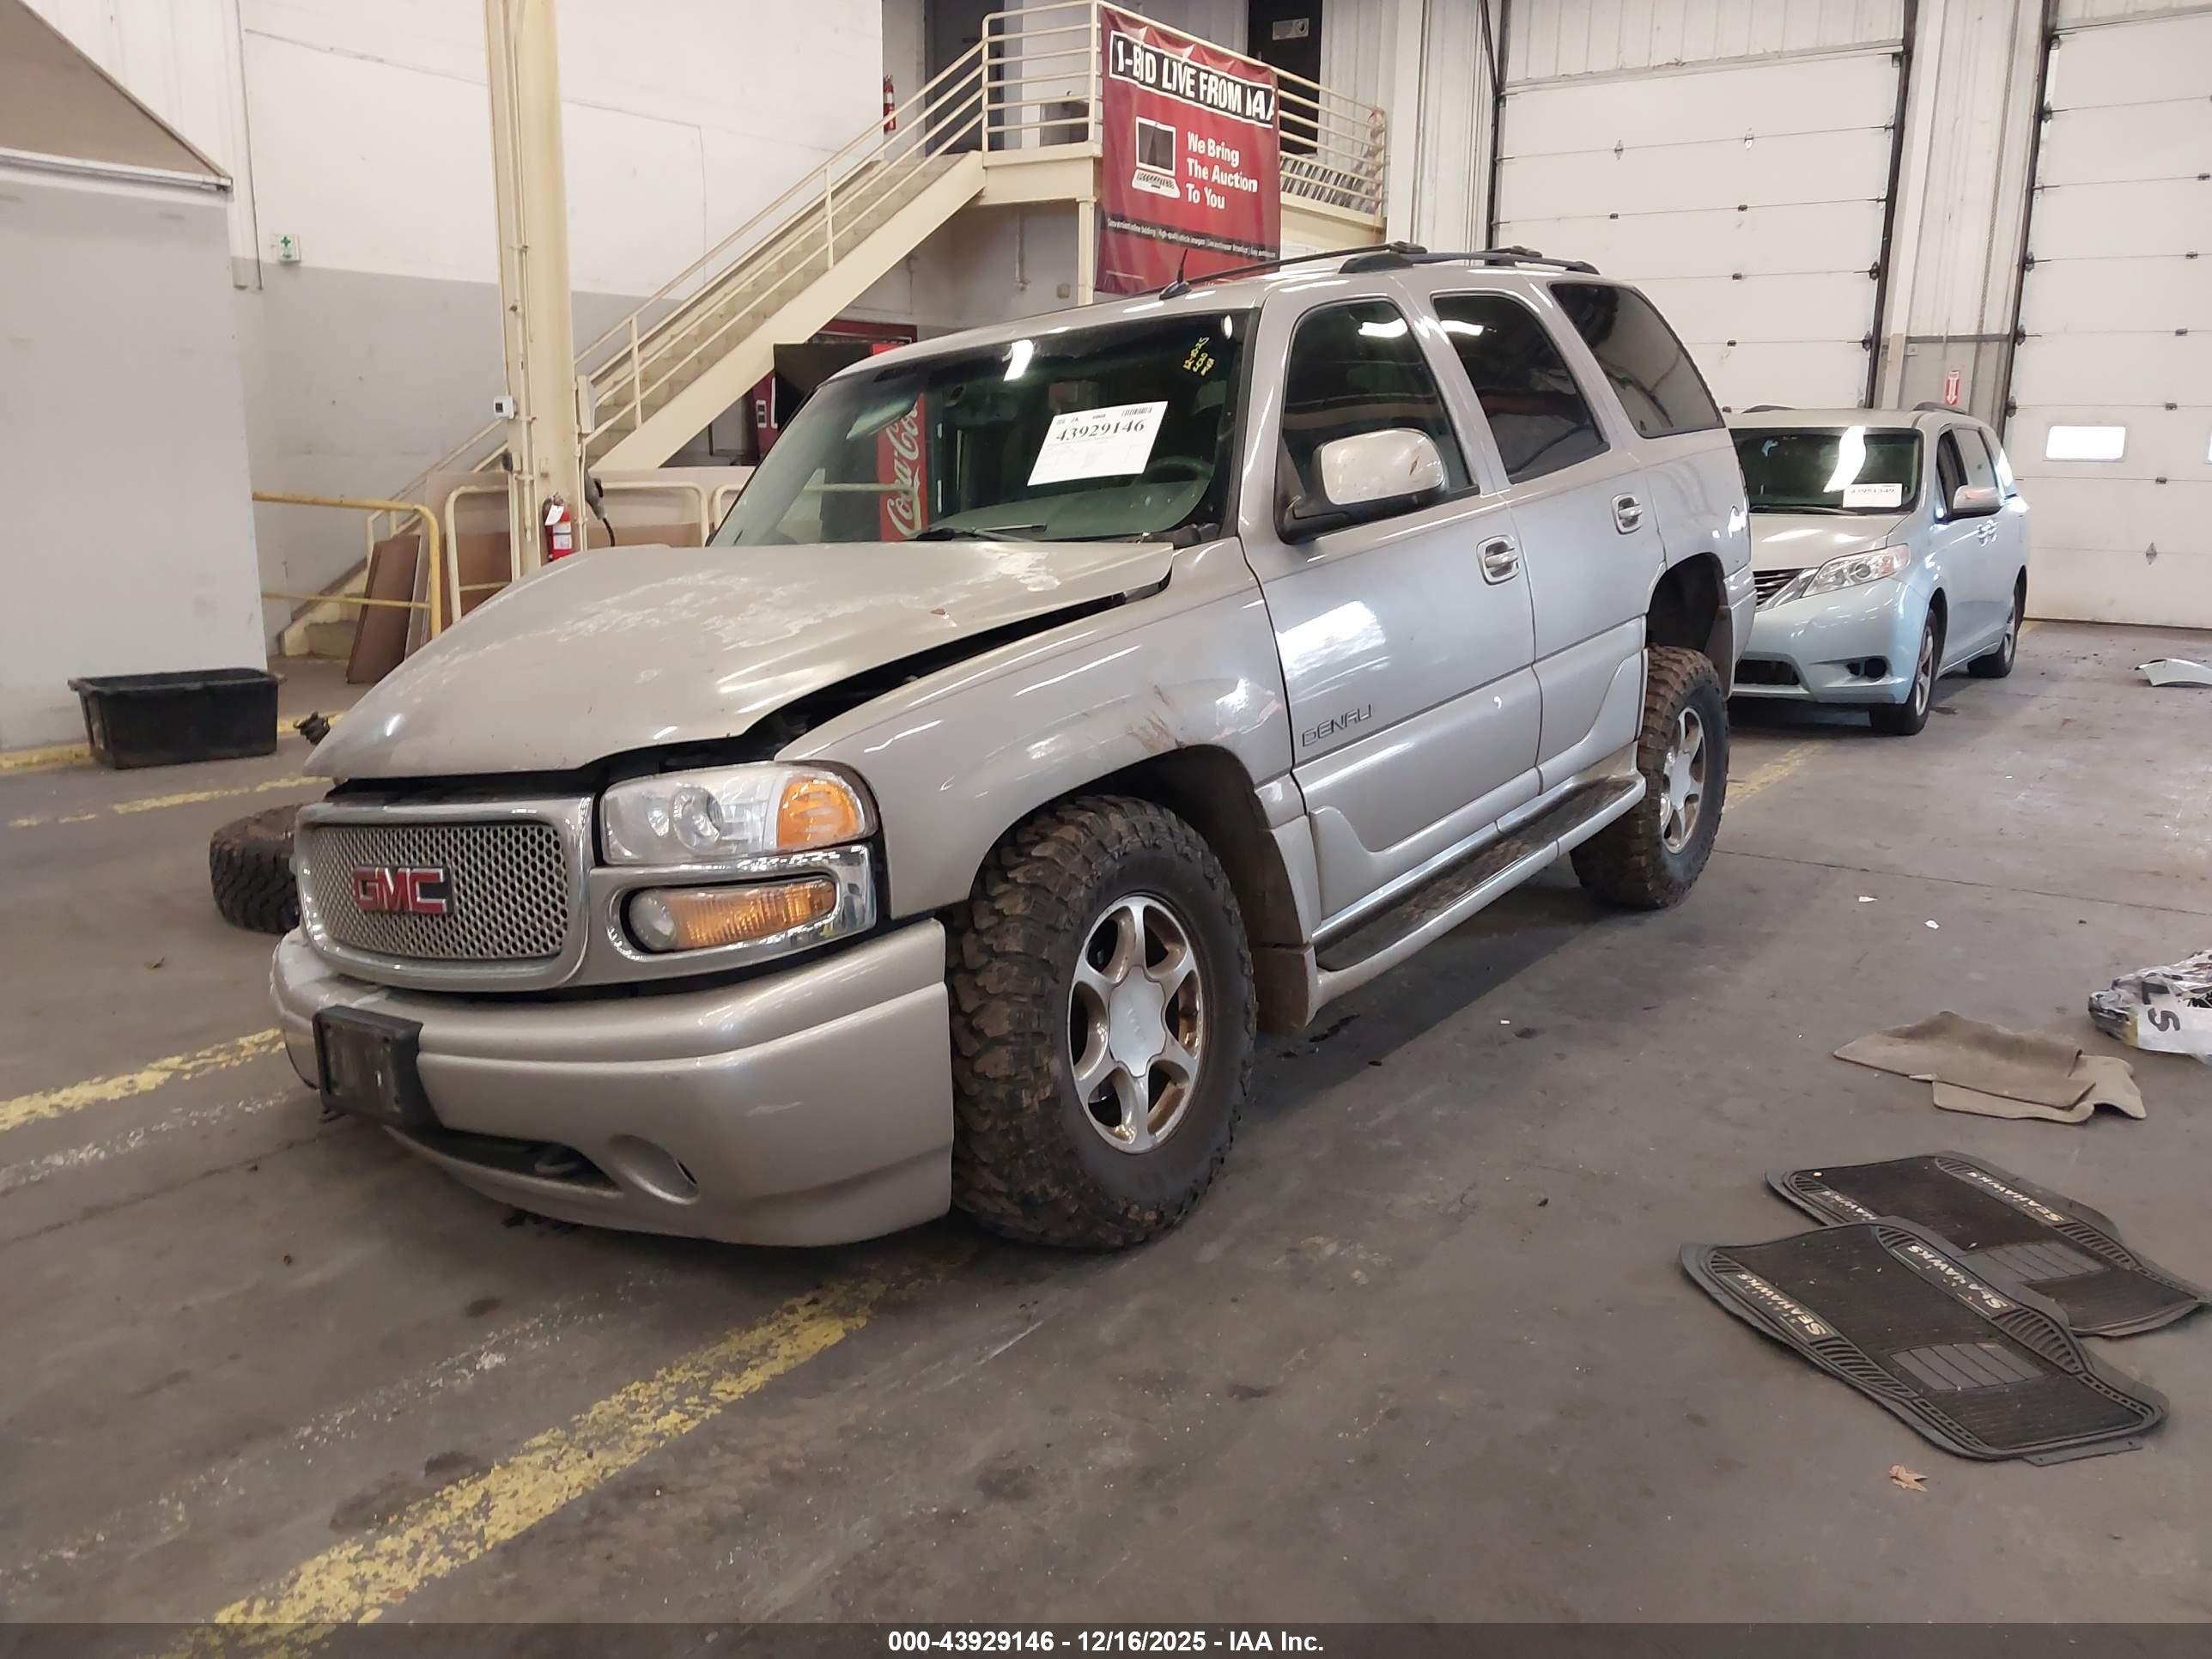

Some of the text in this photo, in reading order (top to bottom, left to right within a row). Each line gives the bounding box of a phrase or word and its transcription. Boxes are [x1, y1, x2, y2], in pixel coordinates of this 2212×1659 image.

[1117, 40, 1157, 84] I-BID
[1162, 58, 1197, 99] LIVE
[1199, 71, 1243, 114] FROM
[1187, 131, 1240, 168] We Bring
[1186, 183, 1225, 210] To You
[1187, 157, 1259, 193] The Auction
[1055, 418, 1147, 442] 43929146
[1301, 702, 1372, 748] DENALI
[353, 866, 447, 913] GMC
[1966, 1171, 2065, 1221] SEAHAWKS
[1737, 1273, 1827, 1335] SEAHAWKS
